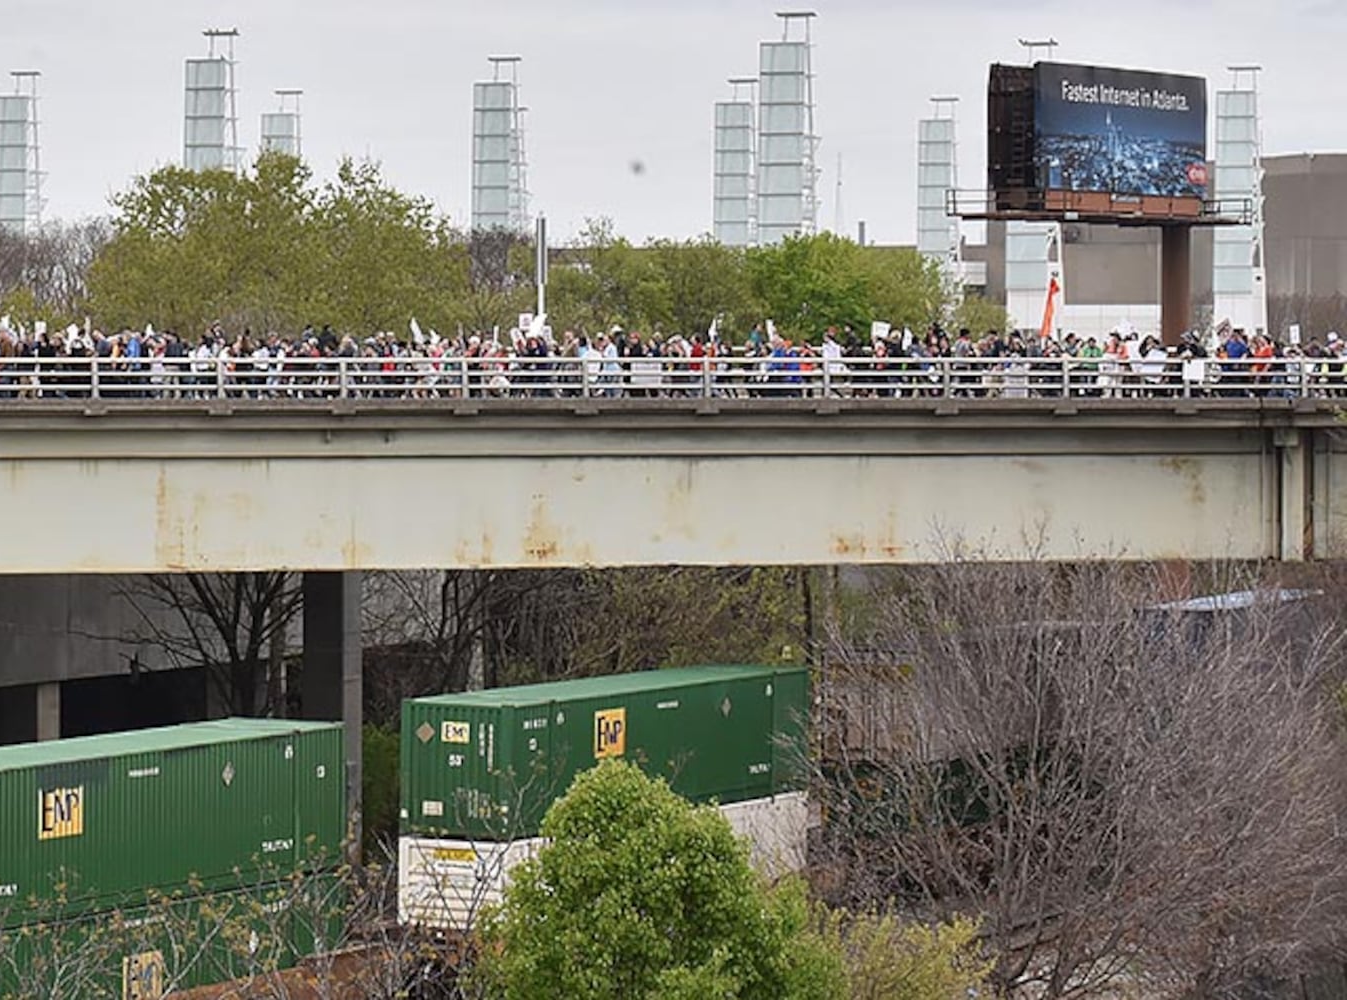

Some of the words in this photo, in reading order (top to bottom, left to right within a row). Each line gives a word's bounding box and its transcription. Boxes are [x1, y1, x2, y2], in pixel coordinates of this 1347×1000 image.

[1061, 80, 1098, 103] Fastest
[1099, 84, 1139, 107] Internet
[1140, 87, 1151, 108] in
